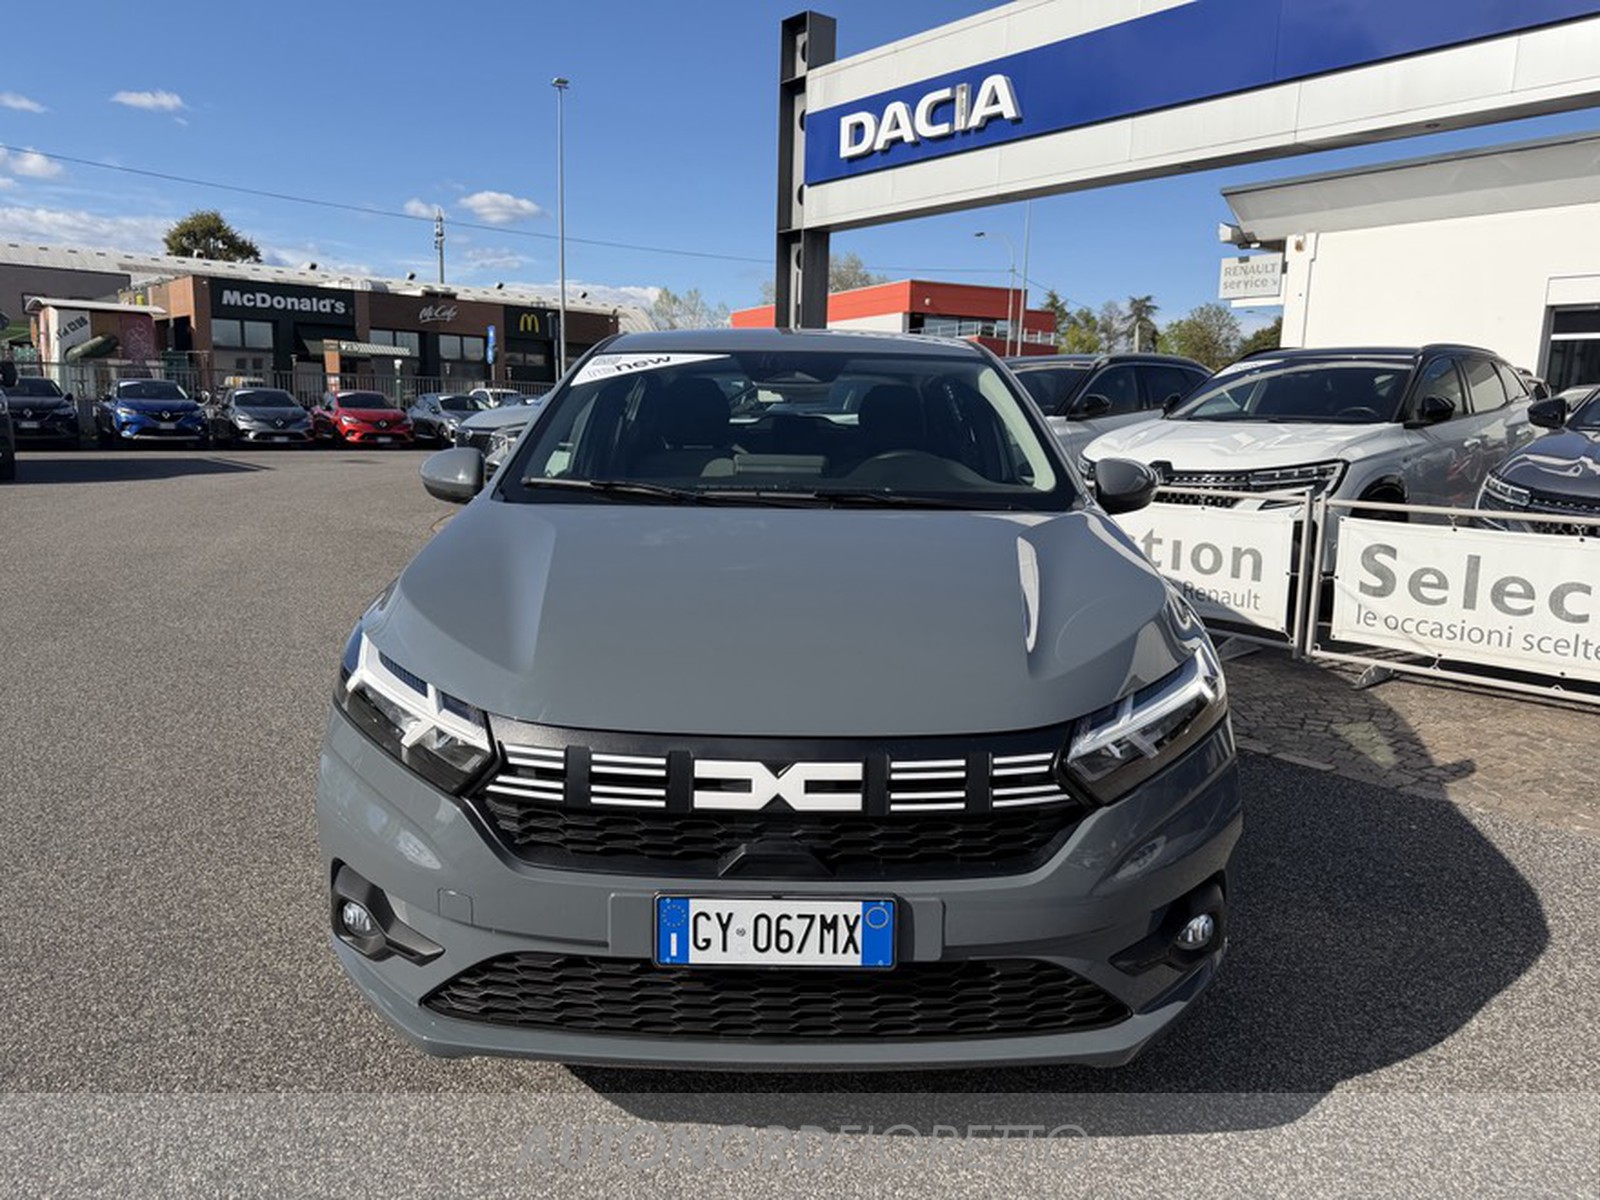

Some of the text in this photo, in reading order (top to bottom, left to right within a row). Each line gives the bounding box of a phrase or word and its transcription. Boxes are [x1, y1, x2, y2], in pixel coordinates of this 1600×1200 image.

[839, 74, 1021, 159] DACIA
[1223, 278, 1269, 290] service
[1224, 263, 1277, 277] RENAULT
[221, 290, 346, 314] McDonald's
[1129, 528, 1263, 582] tion
[1182, 580, 1261, 610] Renault
[1358, 543, 1593, 624] Selec
[1355, 603, 1378, 628] le
[1383, 614, 1514, 649] occasioni
[692, 911, 734, 953] GY
[752, 913, 861, 954] 067MX
